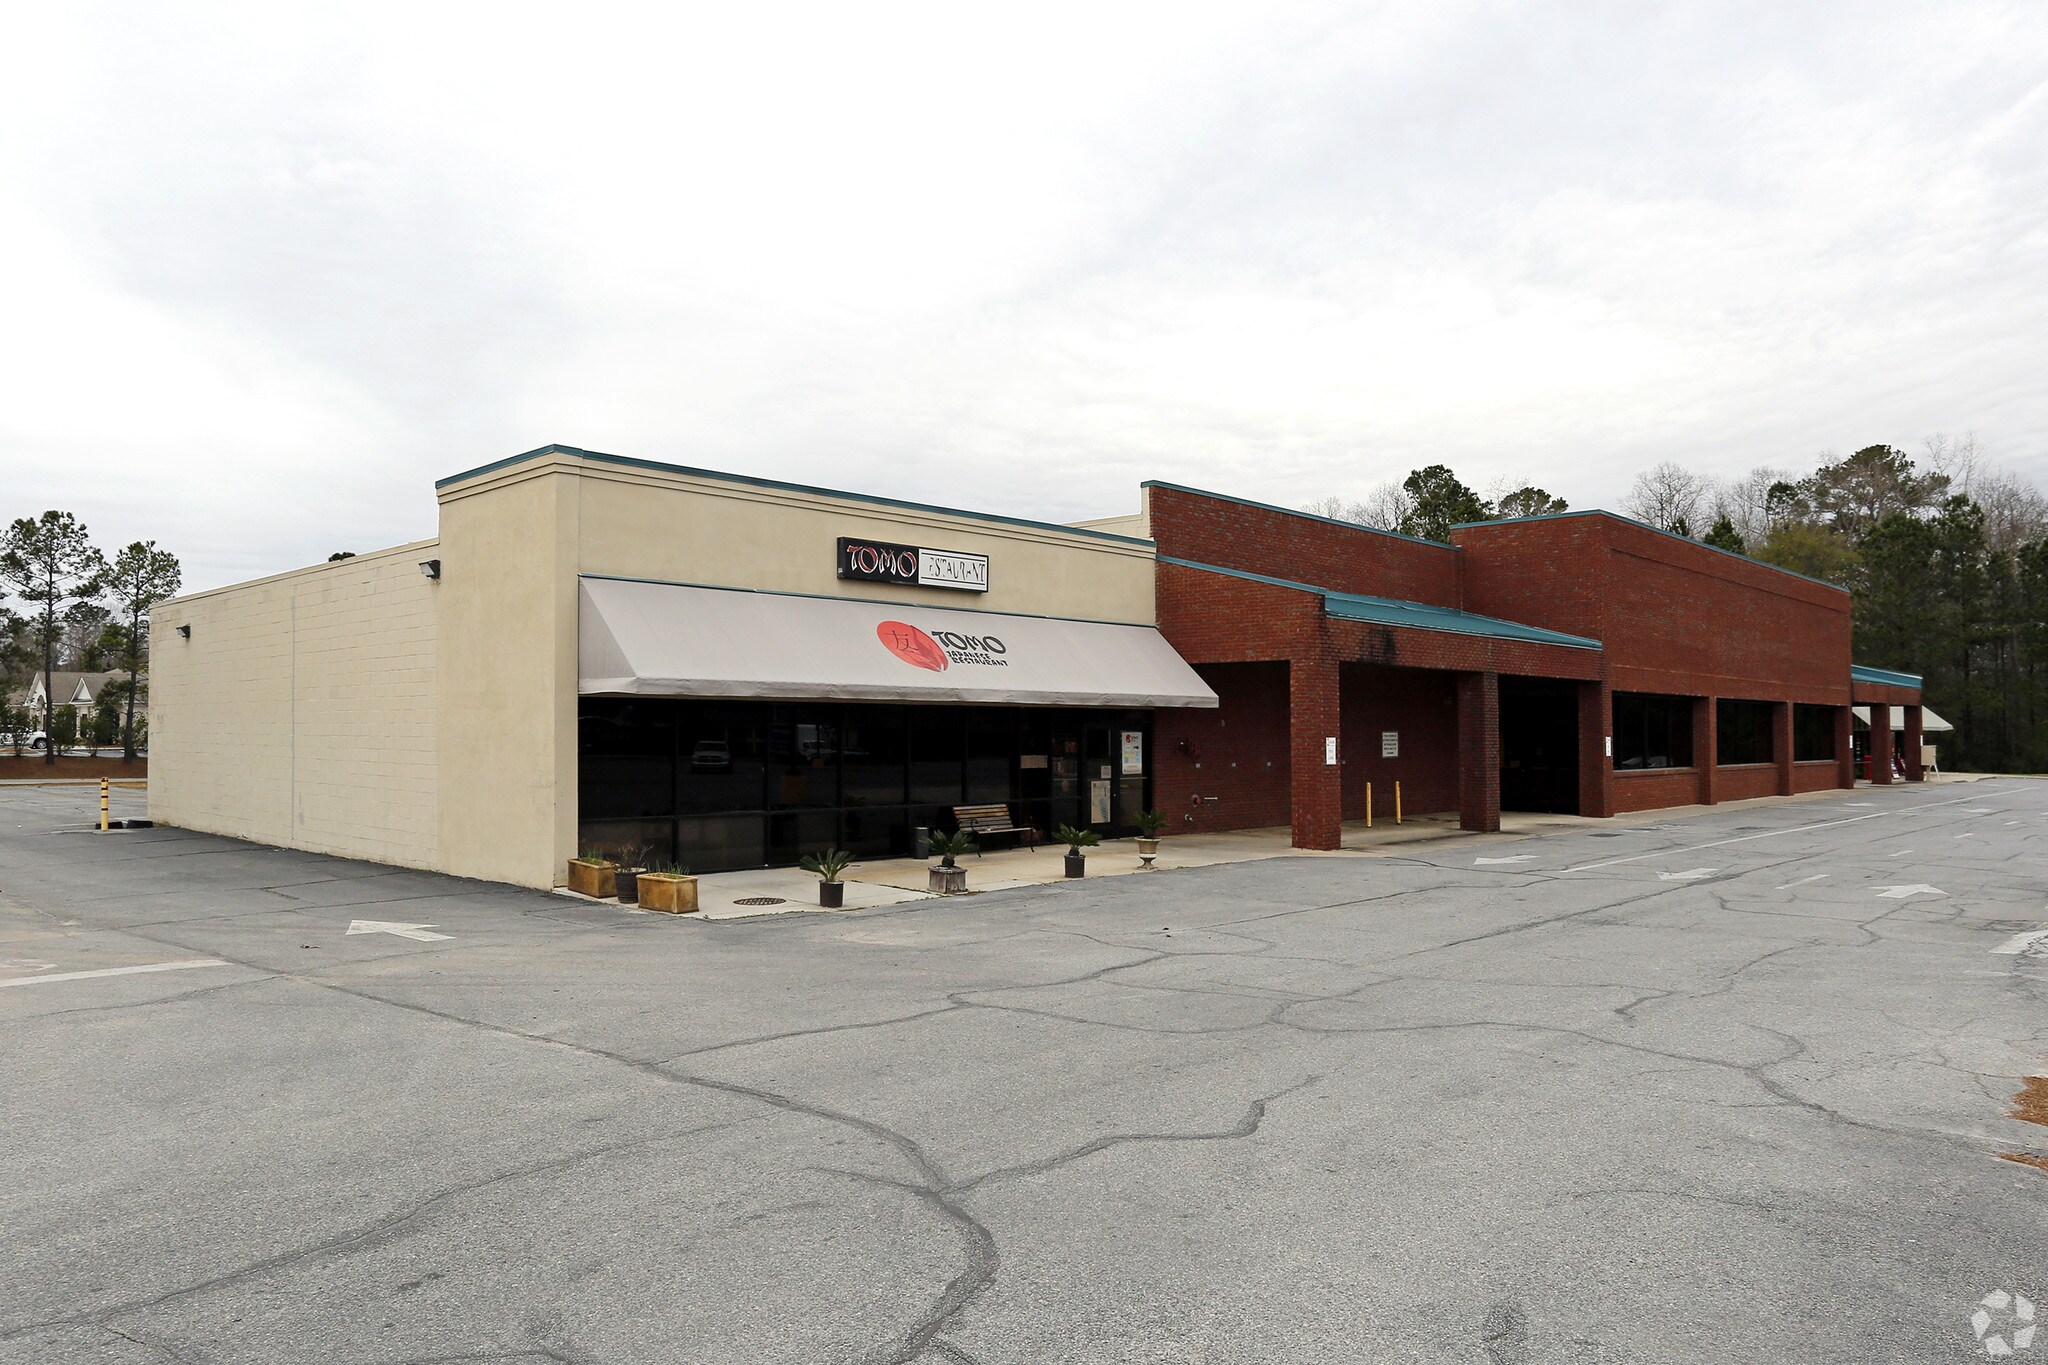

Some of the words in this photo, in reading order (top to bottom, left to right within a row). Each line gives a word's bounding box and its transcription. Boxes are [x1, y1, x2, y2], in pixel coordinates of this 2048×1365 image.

[847, 545, 917, 577] TOMO
[928, 557, 985, 582] SAURANT
[931, 631, 1007, 654] TOMO
[946, 651, 991, 660] JAPANESE
[952, 657, 1008, 666] RESTAURANT
